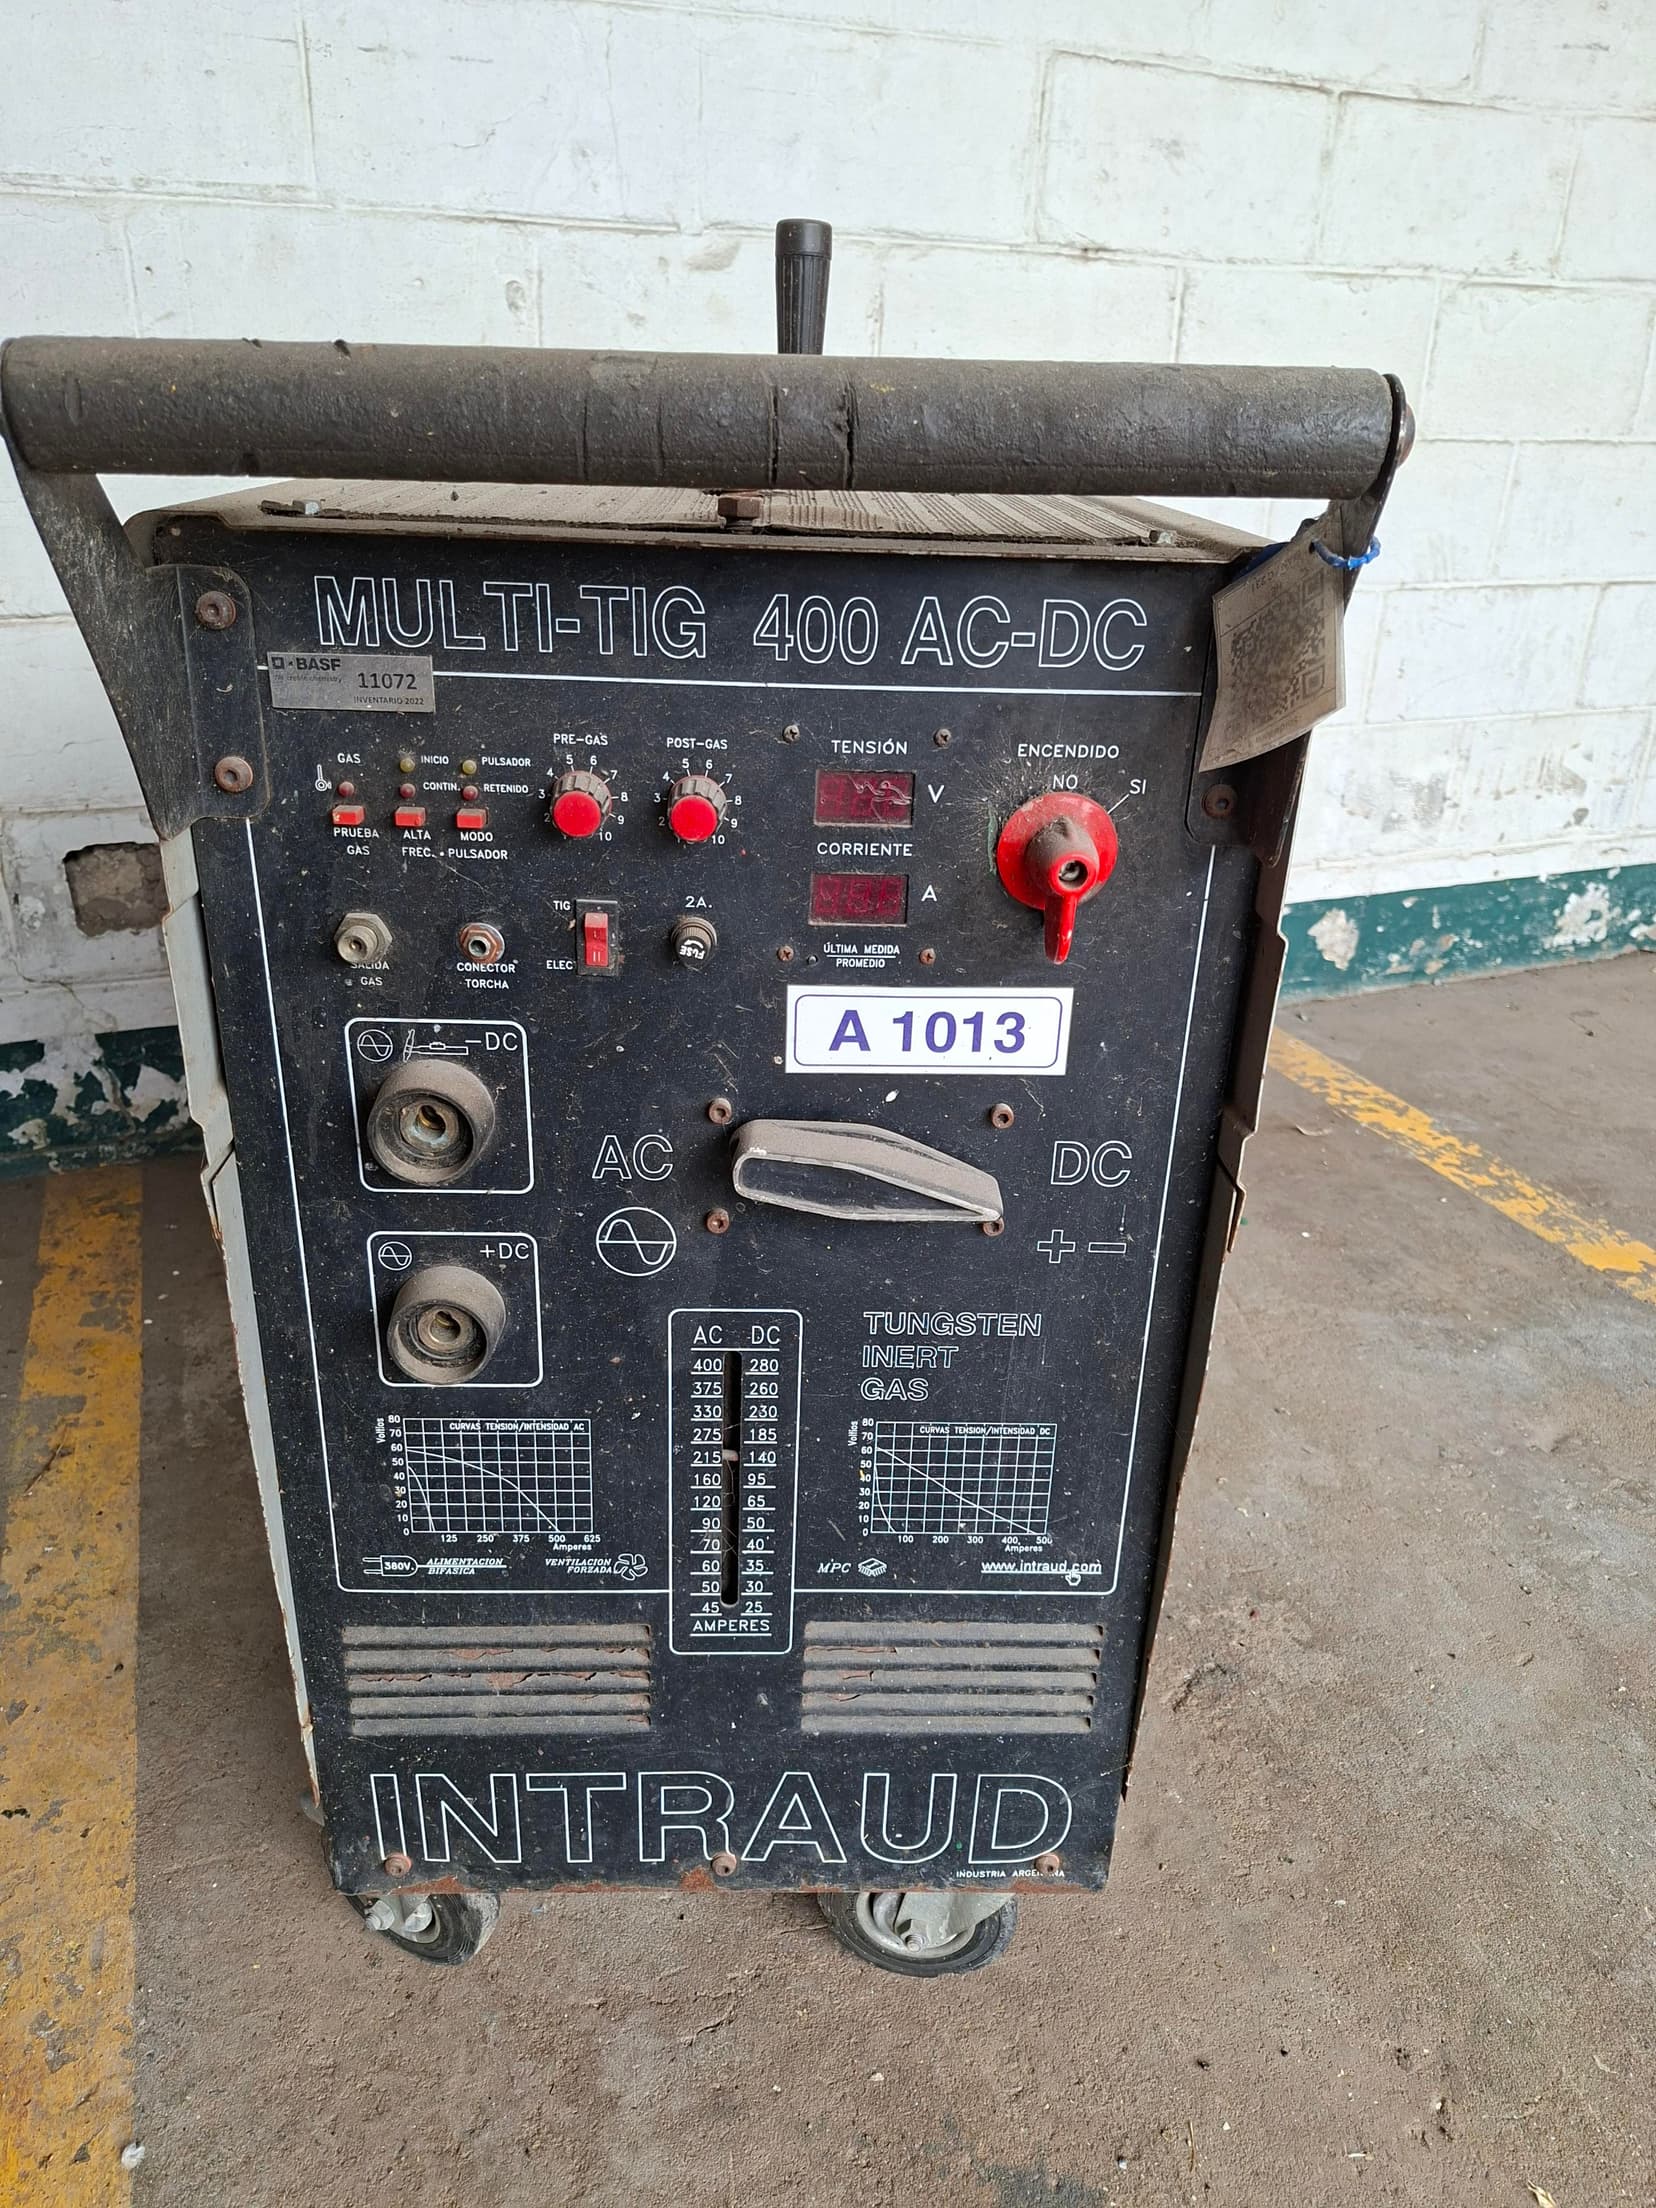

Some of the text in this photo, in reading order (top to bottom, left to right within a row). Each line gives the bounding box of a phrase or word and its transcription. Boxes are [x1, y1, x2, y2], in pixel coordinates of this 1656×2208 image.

[313, 575, 1148, 670] MULTI-TIG 400 AC-DC
[296, 657, 341, 671] BASF
[357, 672, 418, 690] 11072
[353, 696, 424, 706] INVENTARIO 2022
[553, 733, 609, 746] PRE-GAS
[666, 737, 729, 750] POST-GAS
[831, 738, 908, 755] TENSIÓN
[1017, 743, 1120, 759] ENCENDIDO
[337, 753, 361, 764] GAS
[420, 755, 450, 765] INICIO
[481, 756, 531, 767] PULSADOR
[566, 754, 574, 765] 5
[590, 755, 597, 766] 6
[682, 758, 690, 769] 5
[706, 759, 713, 769] 6
[546, 768, 554, 777] 4
[610, 770, 618, 780] 7
[662, 771, 670, 781] 4
[725, 774, 733, 784] 7
[1052, 774, 1078, 790] NO
[423, 782, 461, 792] CONTIN.
[483, 783, 529, 794] RETENIDO
[1129, 779, 1147, 795] SI
[538, 789, 546, 799] 3
[621, 792, 629, 801] 8
[653, 792, 661, 802] 3
[927, 784, 945, 803] V
[735, 795, 742, 805] 8
[617, 815, 625, 825] 9
[658, 816, 666, 826] 2
[730, 818, 738, 828] 9
[333, 827, 379, 839] PRUEBA
[403, 830, 432, 840] ALTA
[460, 832, 494, 843] MODO
[712, 834, 725, 844] 10
[346, 845, 370, 856] GAS
[402, 847, 436, 858] FREC.
[448, 848, 509, 860] PULSADOR
[817, 842, 913, 857] CORRIENTE
[921, 884, 938, 902] A
[553, 900, 571, 911] TIG
[679, 945, 706, 960] FUSE
[823, 942, 900, 954] ÚLTIMA MEDIDA
[456, 962, 516, 973] CONECTOR
[546, 960, 573, 970] ELEC
[836, 958, 886, 968] PROMEDIO
[360, 976, 383, 987] GAS
[465, 978, 509, 989] TORCHA
[828, 1009, 1027, 1054] A 1013
[592, 1134, 674, 1181] AC
[1050, 1140, 1133, 1188] DC
[863, 1311, 1042, 1337] TUNGSTEN
[693, 1325, 781, 1345] AC DC
[862, 1345, 959, 1369] INERT
[693, 1358, 779, 1372] 400 280
[693, 1381, 778, 1395] 375 260
[860, 1377, 929, 1401] GAS
[693, 1405, 778, 1418] 330 230
[388, 1415, 400, 1423] 80
[862, 1418, 874, 1426] 80
[449, 1422, 481, 1431] CURVAS
[573, 1423, 585, 1431] AC
[919, 1426, 1051, 1436] CURVAS TENSION/INTENSIDAD DC
[389, 1429, 402, 1437] 70
[693, 1428, 777, 1441] 275 185
[862, 1432, 873, 1440] 70
[390, 1443, 403, 1452] 60
[861, 1446, 873, 1454] 60
[392, 1458, 404, 1466] 50
[693, 1451, 776, 1464] 215 140
[860, 1460, 872, 1468] 50
[393, 1472, 405, 1480] 40
[694, 1473, 766, 1486] 160 95
[395, 1486, 406, 1495] 30
[859, 1487, 870, 1496] 30
[396, 1500, 407, 1508] 20
[694, 1495, 766, 1508] 120 65
[858, 1501, 870, 1509] 20
[397, 1514, 408, 1522] 10
[702, 1517, 765, 1529] 90 50
[859, 1515, 869, 1523] 10
[403, 1528, 409, 1536] 0
[862, 1528, 869, 1536] 0
[441, 1534, 601, 1543] 125 250 375 500 625
[898, 1535, 914, 1543] 100
[932, 1535, 949, 1544] 200
[967, 1536, 983, 1544] 300
[1036, 1536, 1053, 1544] 500
[553, 1543, 592, 1552] Amperes
[703, 1539, 765, 1550] 70 40
[1005, 1545, 1043, 1553] Amperes
[545, 1558, 612, 1567] VENTILACION
[702, 1560, 764, 1572] 60 35
[817, 1562, 852, 1574] MPC
[981, 1560, 1101, 1573] www.intraud.com
[428, 1567, 475, 1575] BIFASICA
[567, 1566, 613, 1574] FORZADA
[702, 1581, 763, 1593] 50 30
[702, 1601, 763, 1613] 45 25
[692, 1620, 770, 1631] AMPERES
[370, 1770, 1073, 1864] INTRAUD
[956, 1869, 1065, 1878] INDUSTRIA ARGENA
